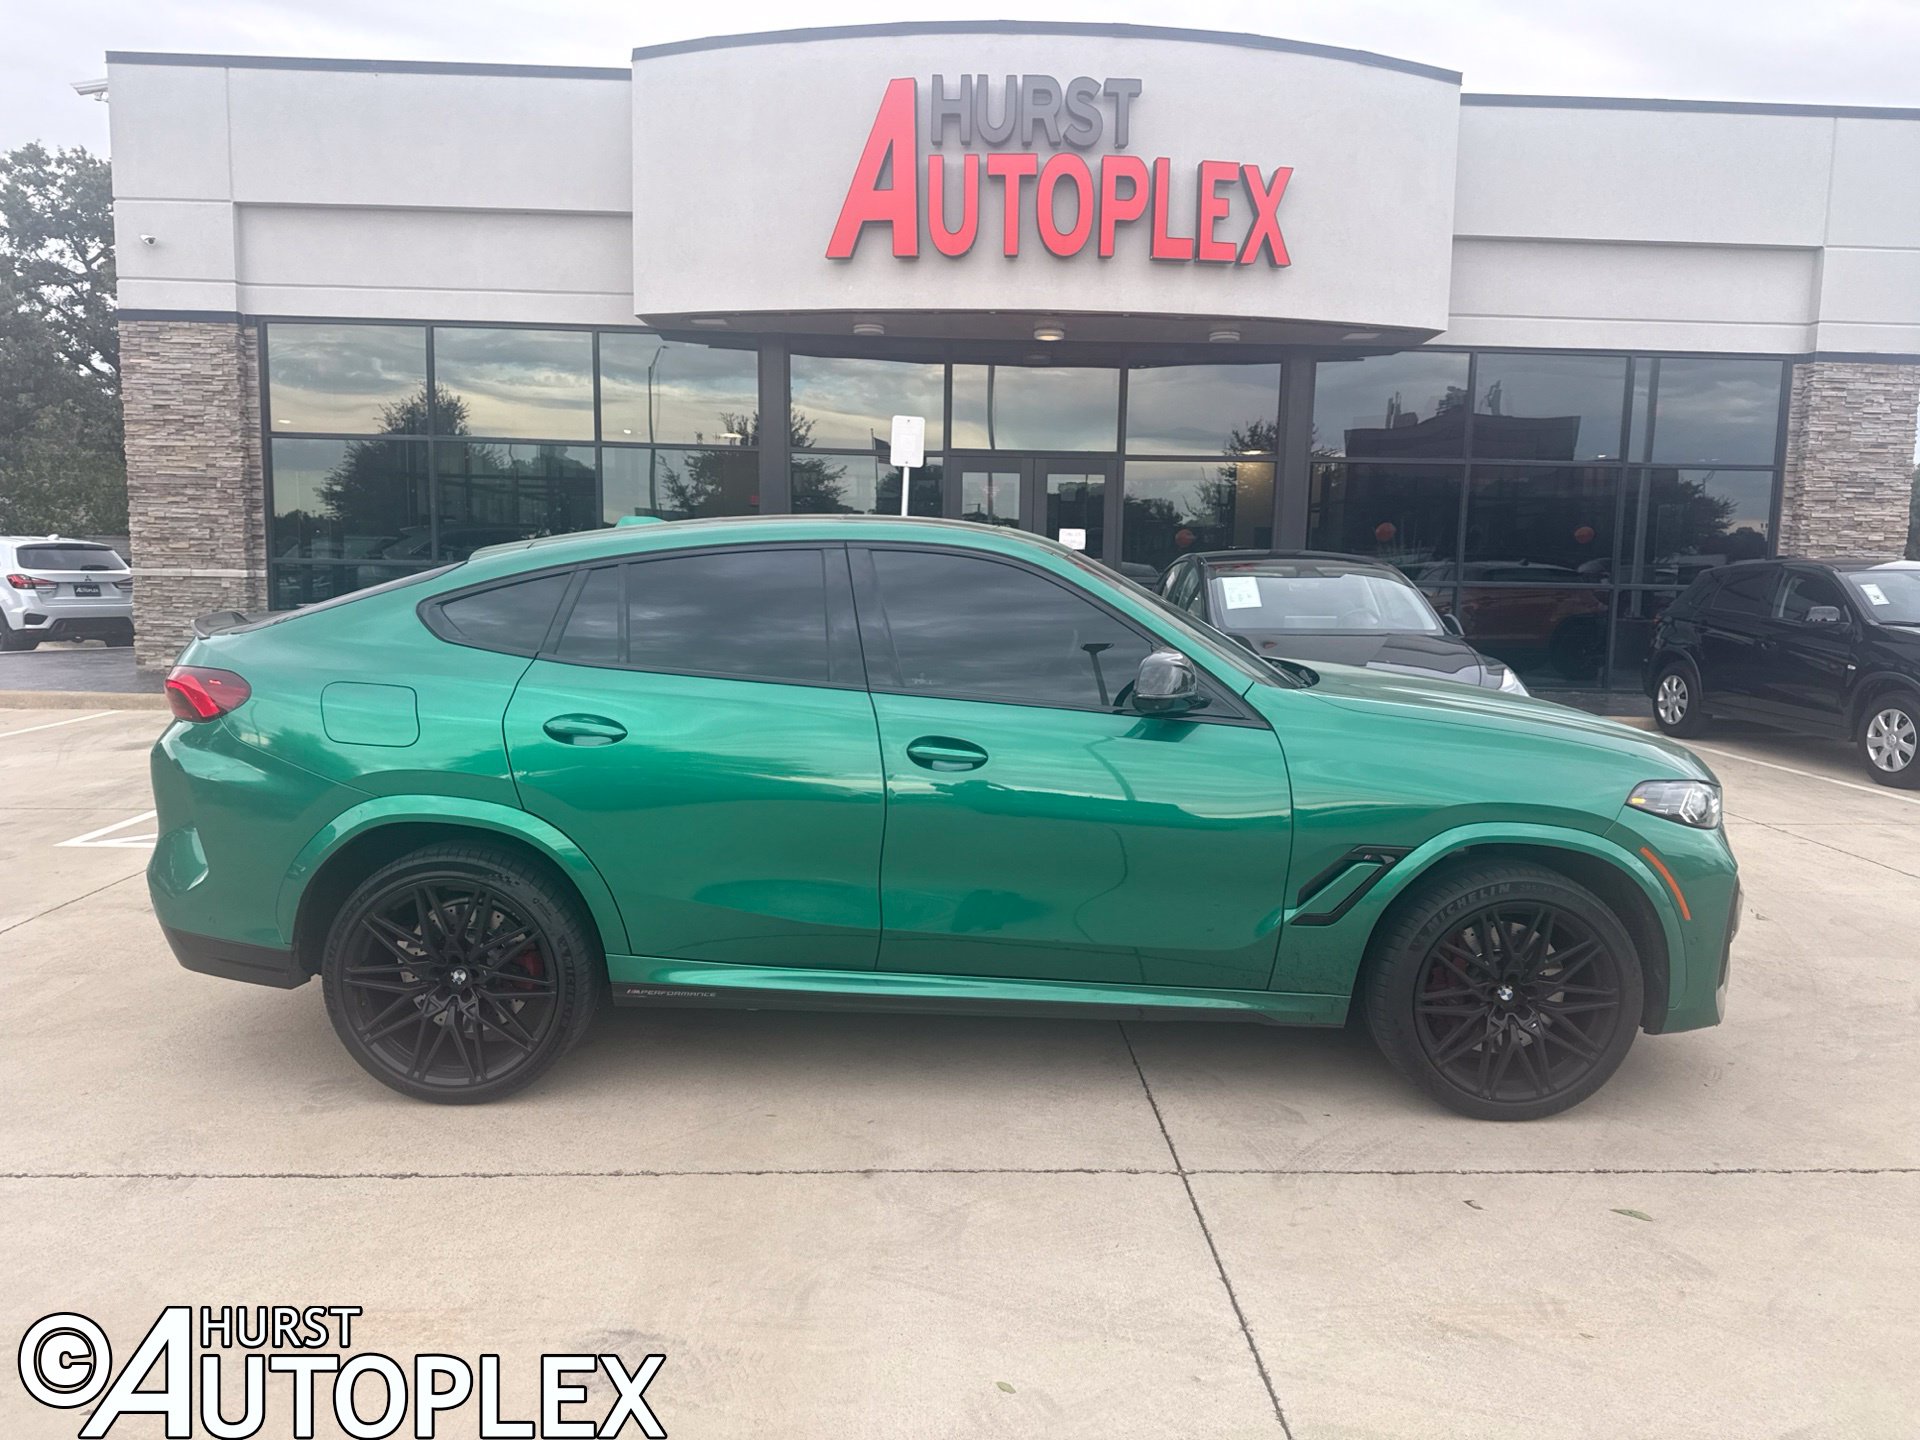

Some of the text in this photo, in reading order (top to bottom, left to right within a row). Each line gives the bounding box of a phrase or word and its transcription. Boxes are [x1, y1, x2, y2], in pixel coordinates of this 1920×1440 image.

[931, 74, 1142, 149] HURST
[825, 77, 1294, 268] AUTOPLEX
[1425, 883, 1511, 933] MICHELIN
